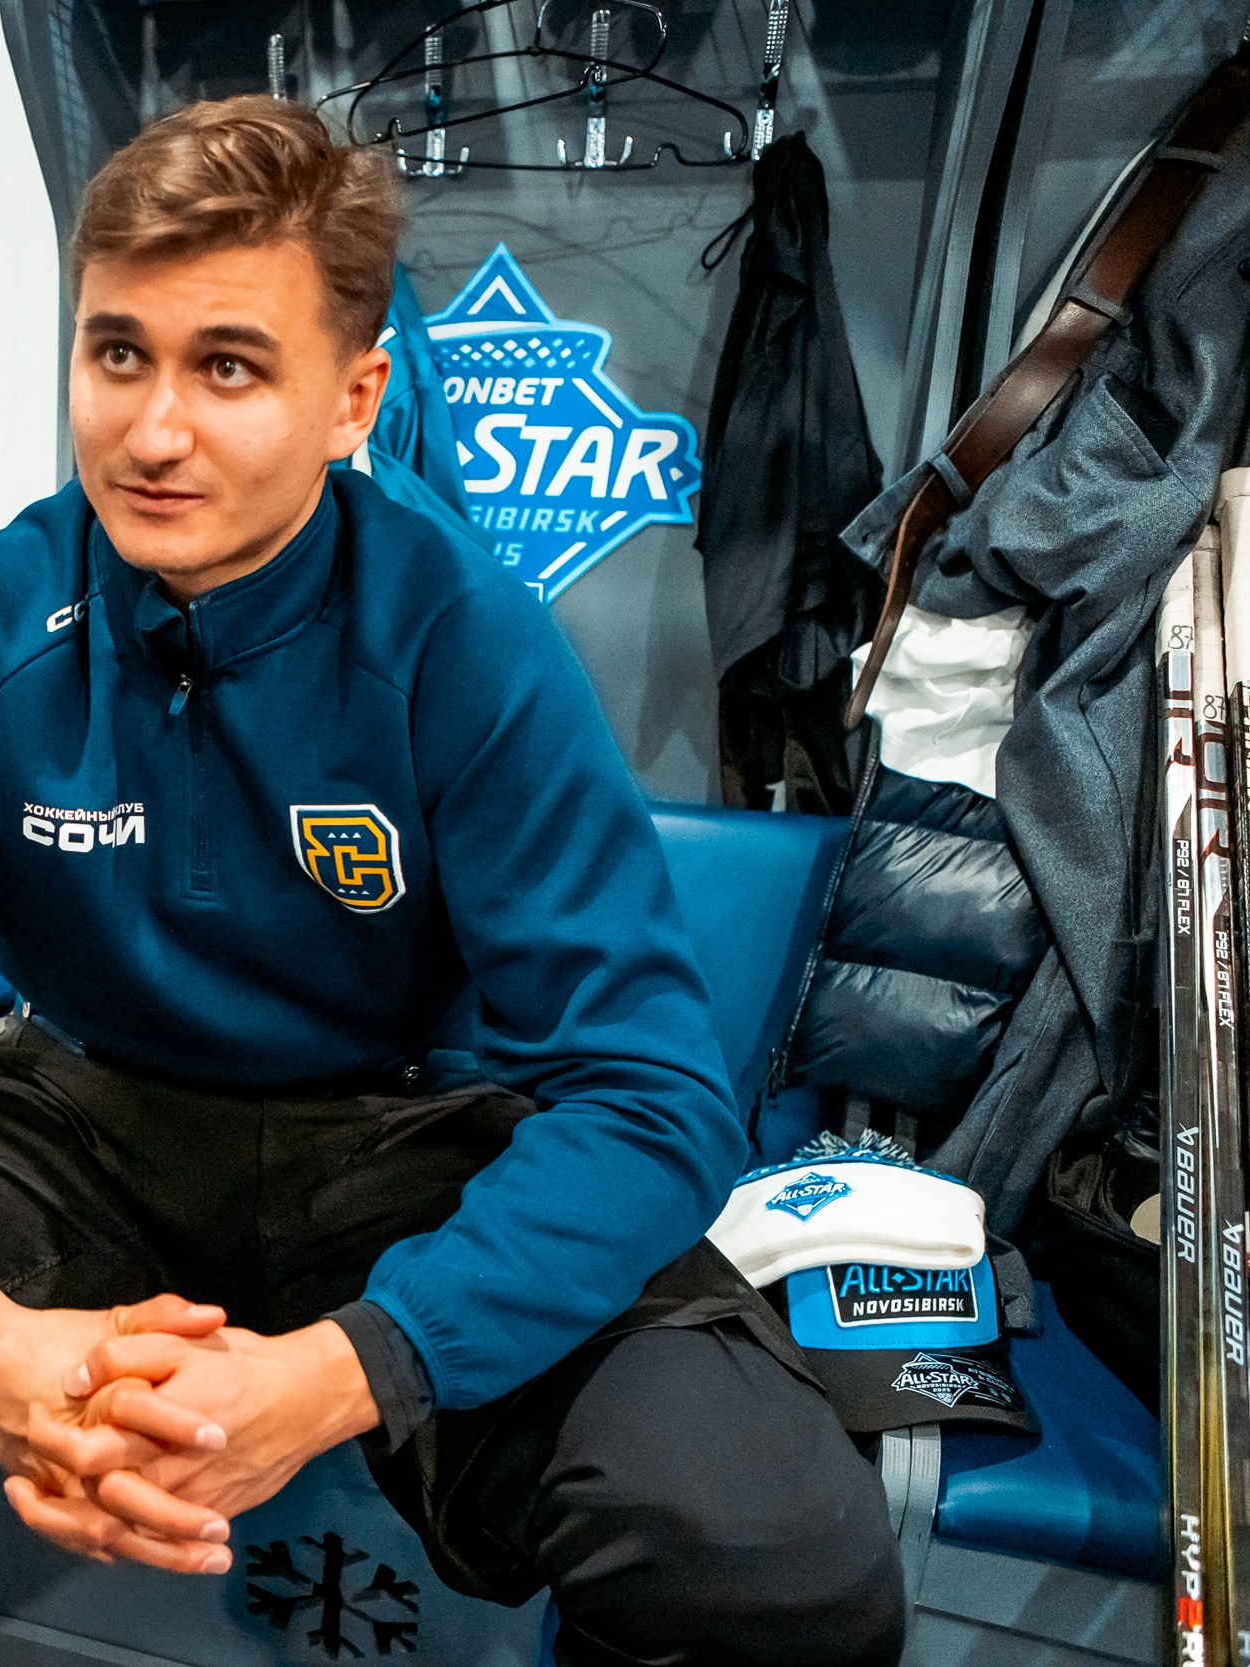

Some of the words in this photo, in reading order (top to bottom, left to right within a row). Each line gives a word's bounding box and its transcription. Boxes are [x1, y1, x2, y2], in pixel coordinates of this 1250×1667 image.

[442, 377, 565, 406] ONBET
[469, 504, 600, 534] SIBIRSK
[22, 815, 146, 853] СОЧИ
[1177, 839, 1190, 868] P92
[1177, 898, 1191, 935] FLEX
[1215, 930, 1228, 960] P92
[1218, 990, 1235, 1030] FLEX
[853, 1297, 965, 1317] NOVOSIBIRSK
[1178, 1513, 1205, 1667] HYPER
